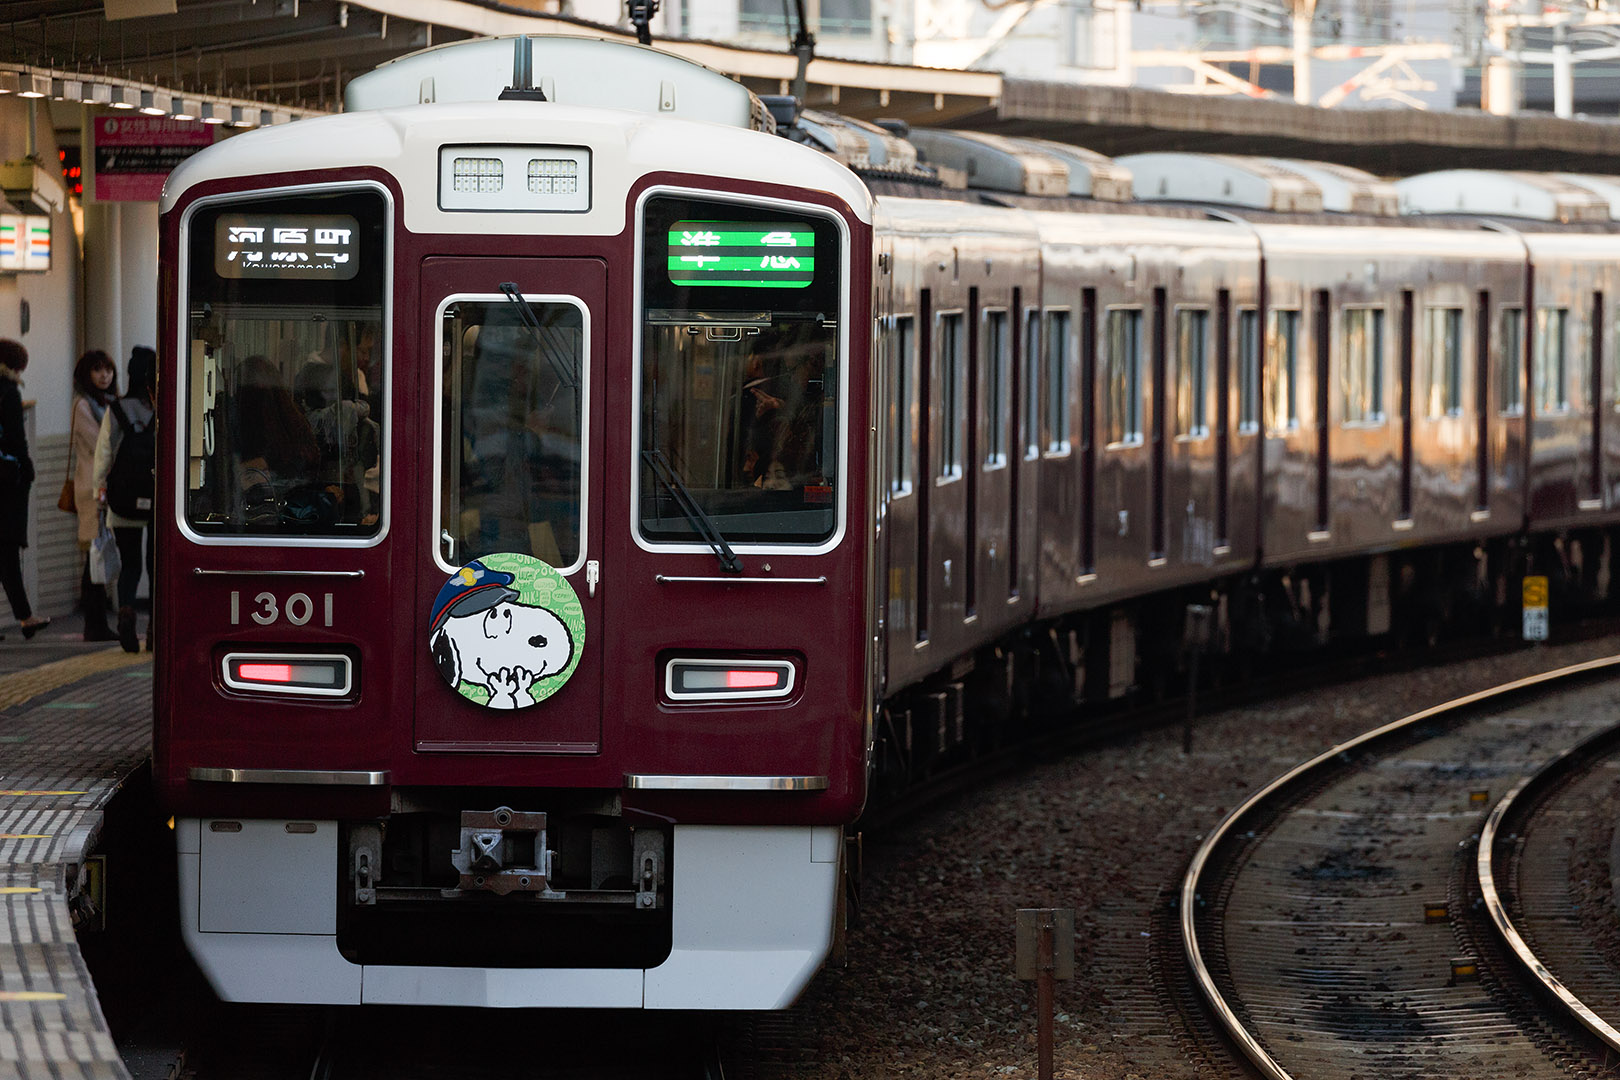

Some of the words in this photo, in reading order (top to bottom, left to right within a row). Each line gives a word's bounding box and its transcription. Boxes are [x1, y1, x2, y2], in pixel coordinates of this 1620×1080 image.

[227, 227, 352, 263] 河原町
[231, 591, 333, 627] 1301
